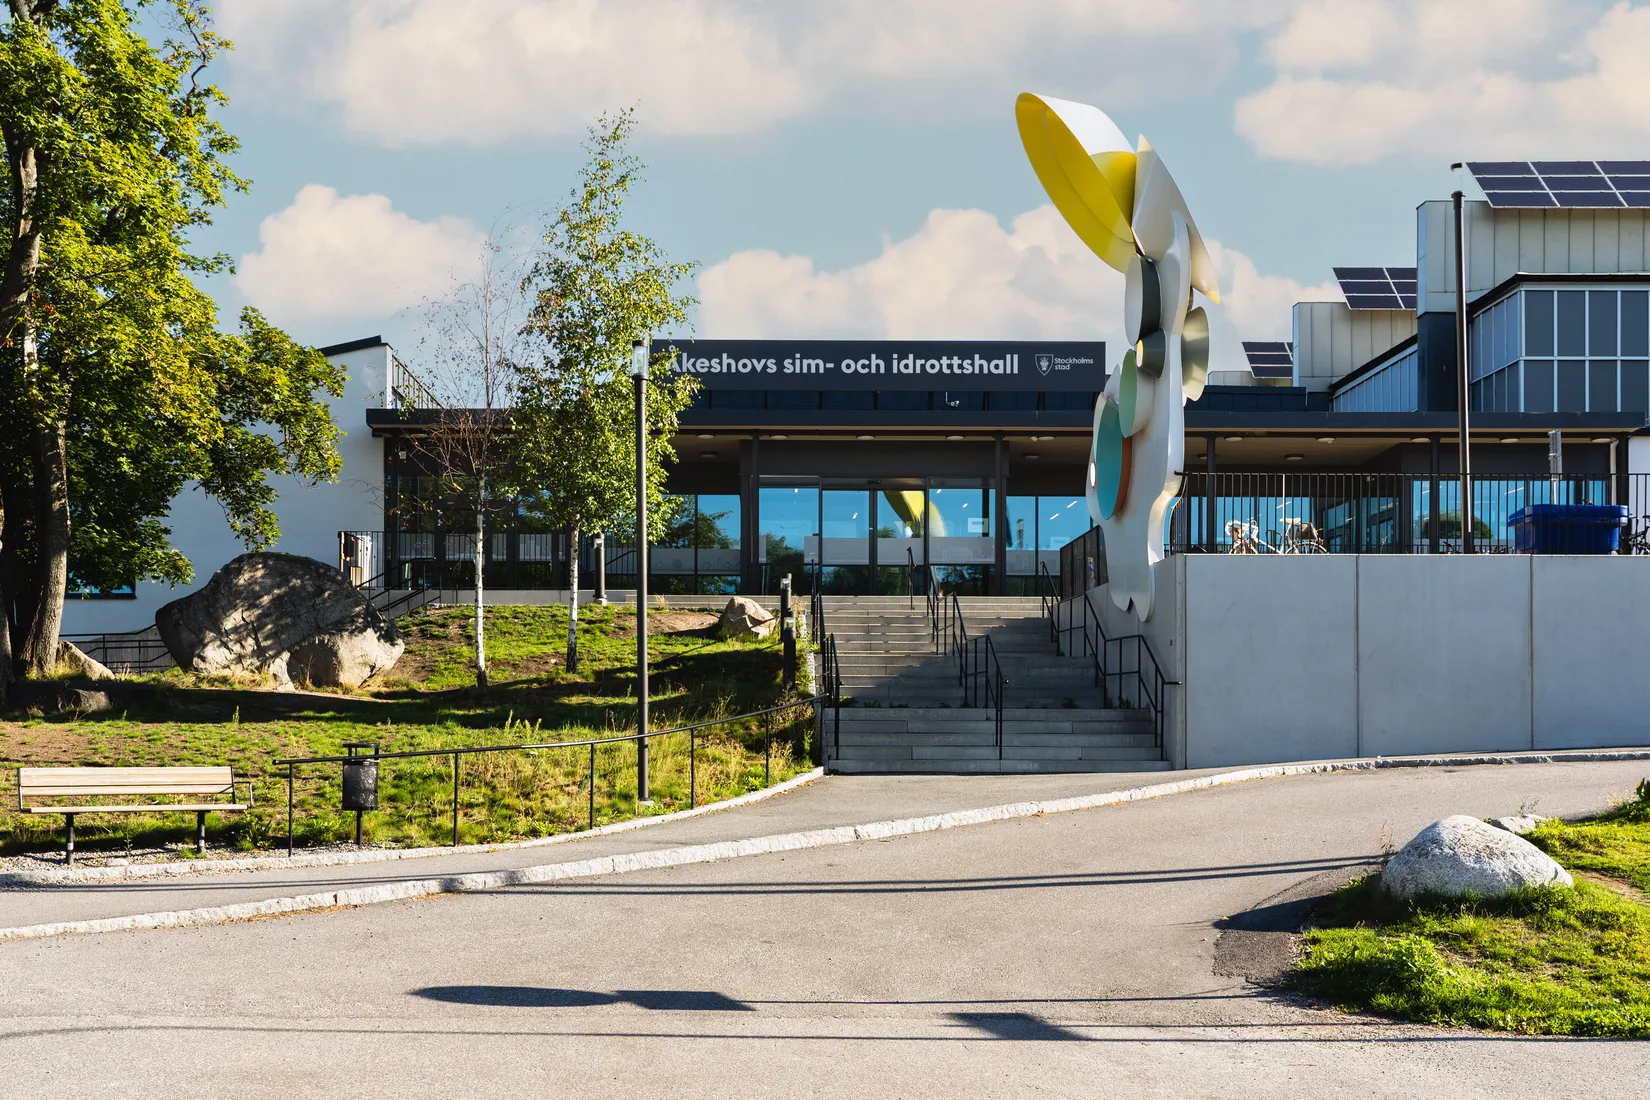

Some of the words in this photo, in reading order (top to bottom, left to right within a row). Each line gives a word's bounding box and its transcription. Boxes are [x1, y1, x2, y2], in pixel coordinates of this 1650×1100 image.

[664, 344, 778, 374] Åkeshovs
[783, 353, 835, 374] sim-
[840, 353, 885, 374] och
[892, 353, 1019, 375] idrottshall
